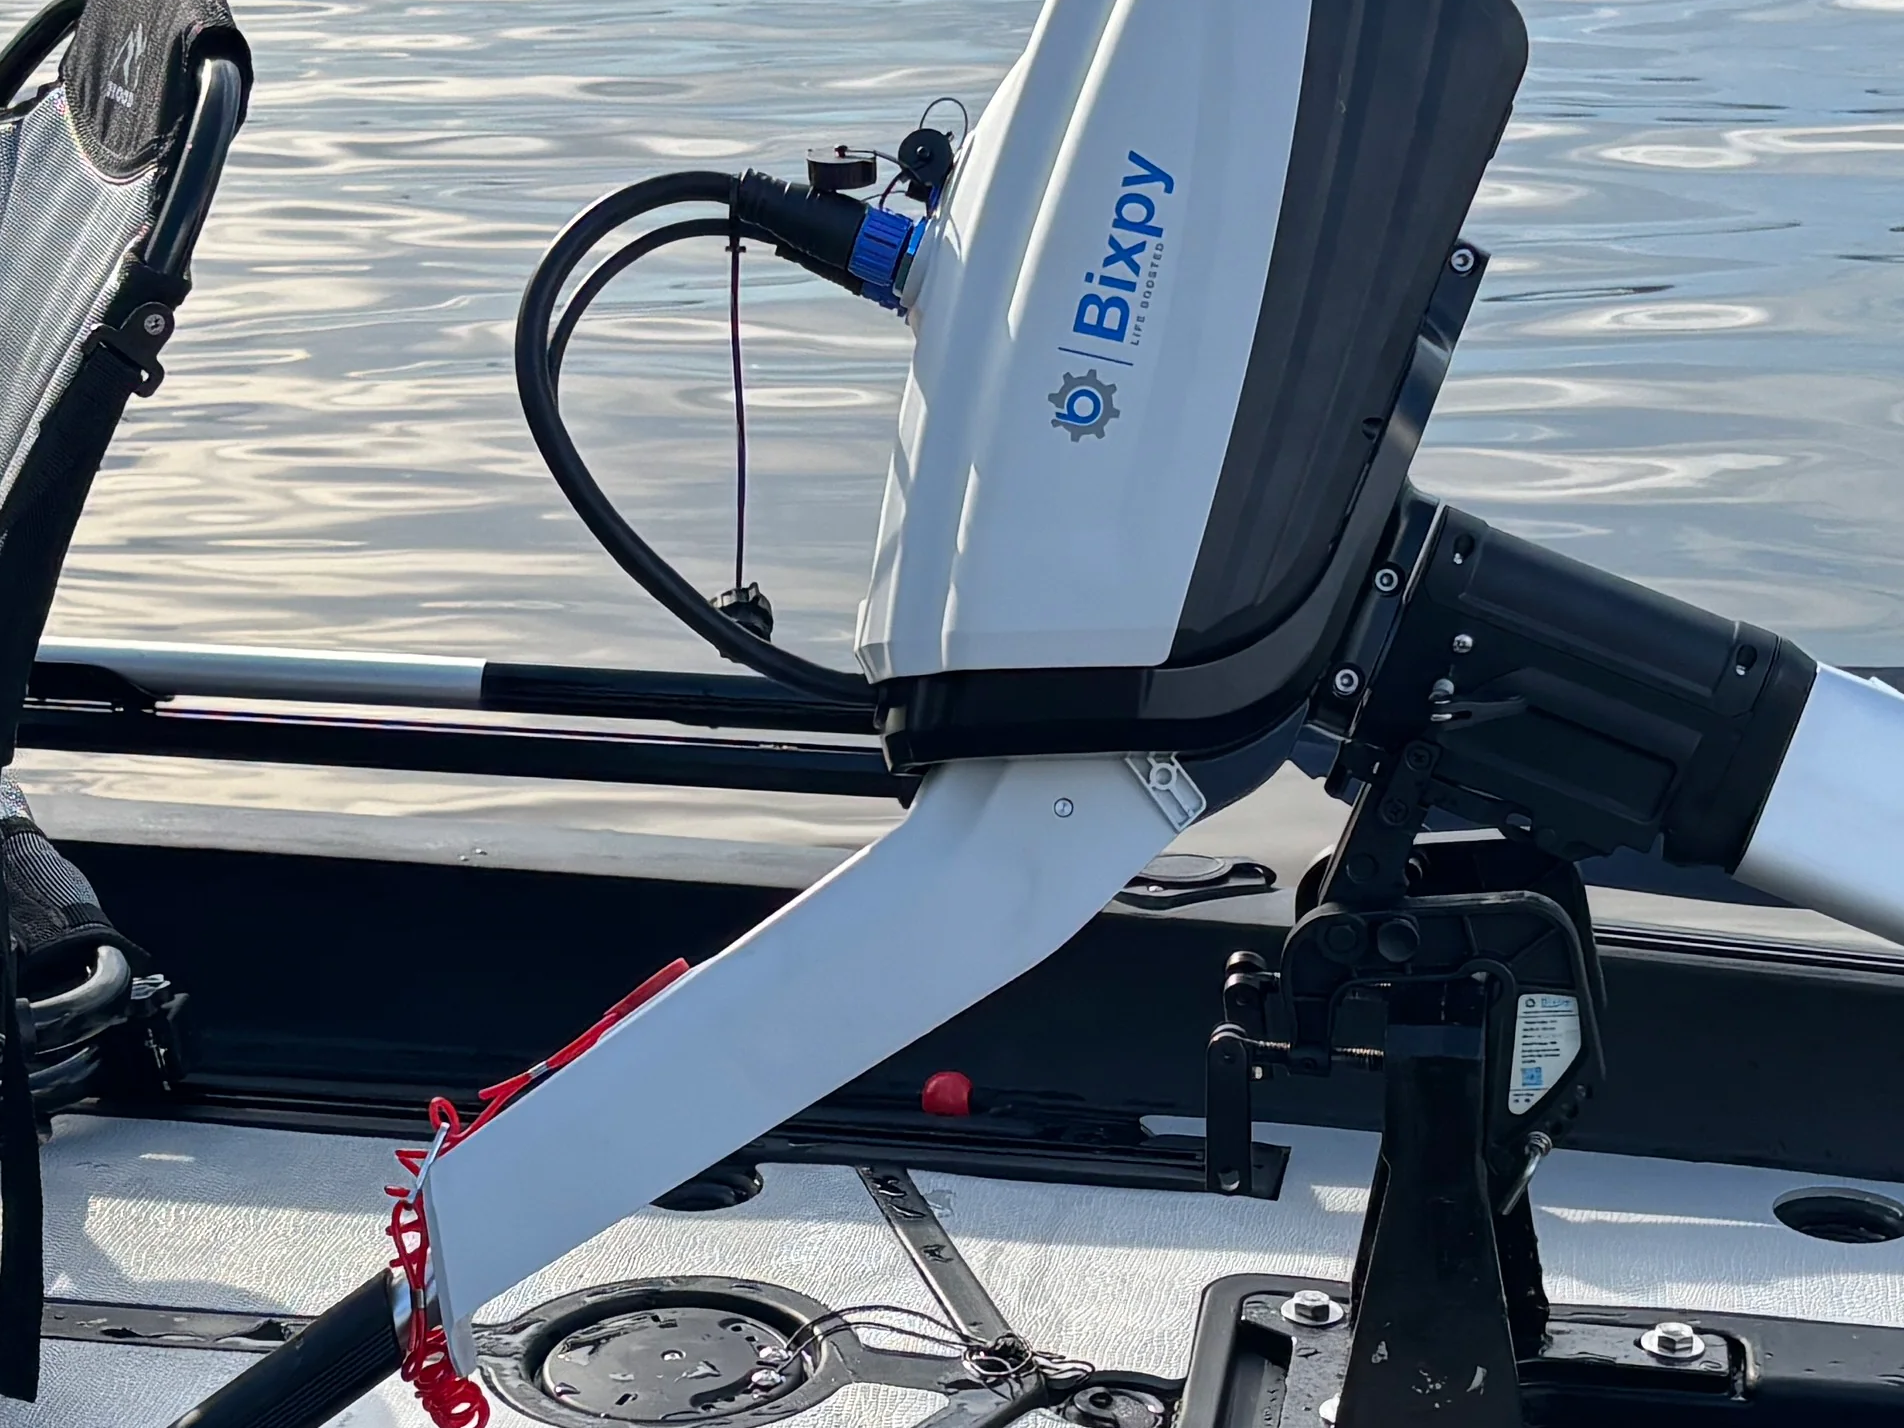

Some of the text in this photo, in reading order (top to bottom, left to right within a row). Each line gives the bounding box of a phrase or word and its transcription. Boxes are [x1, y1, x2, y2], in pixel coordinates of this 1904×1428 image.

[1072, 149, 1175, 343] Bixpy
[1130, 242, 1165, 346] LIFE BOOSTED
